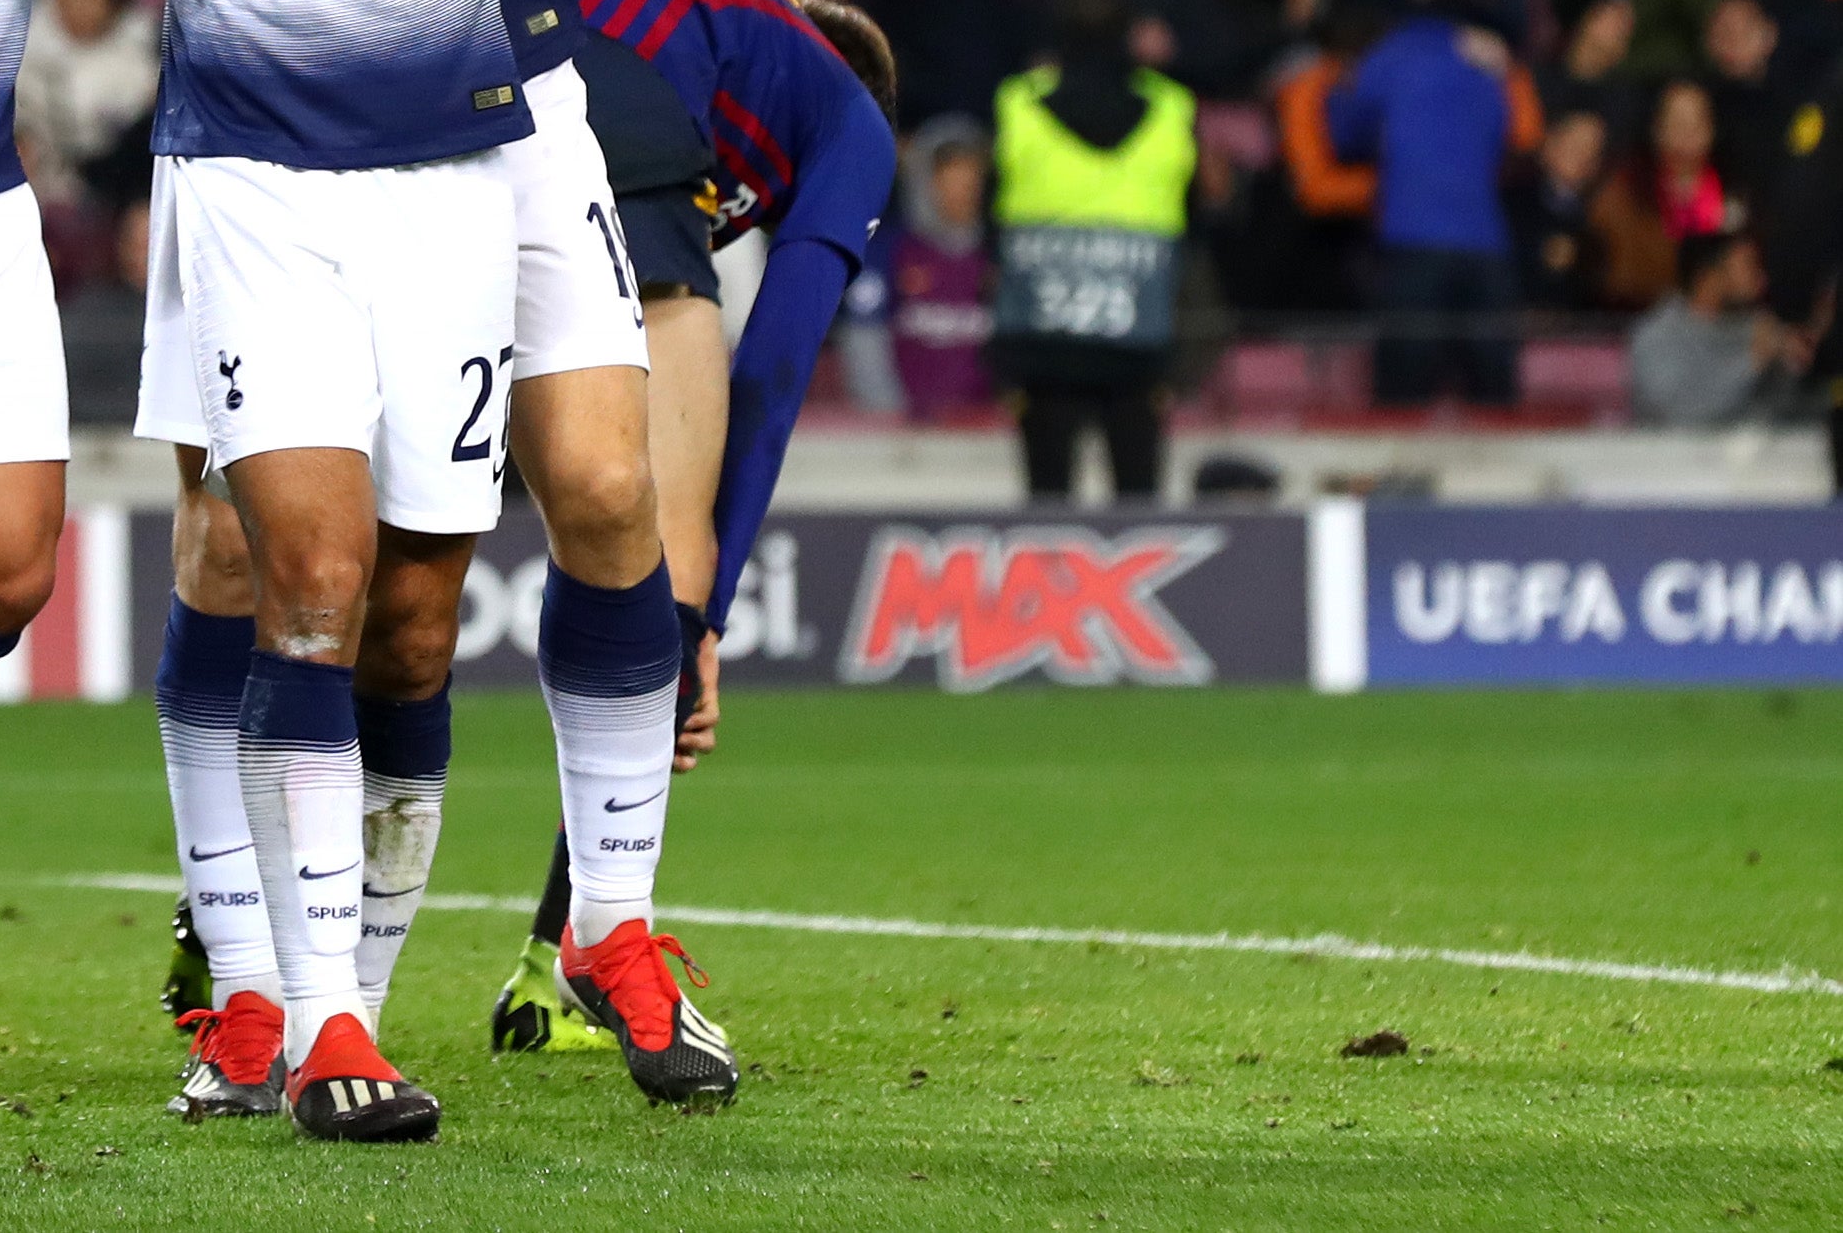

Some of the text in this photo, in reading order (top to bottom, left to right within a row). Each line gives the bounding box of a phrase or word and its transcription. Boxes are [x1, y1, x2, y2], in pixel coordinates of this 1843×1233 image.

[847, 532, 1215, 687] MAX
[1393, 560, 1626, 644] UEFA
[599, 836, 656, 853] SPURS
[199, 891, 259, 907] SPURS
[307, 903, 359, 920] SPURS
